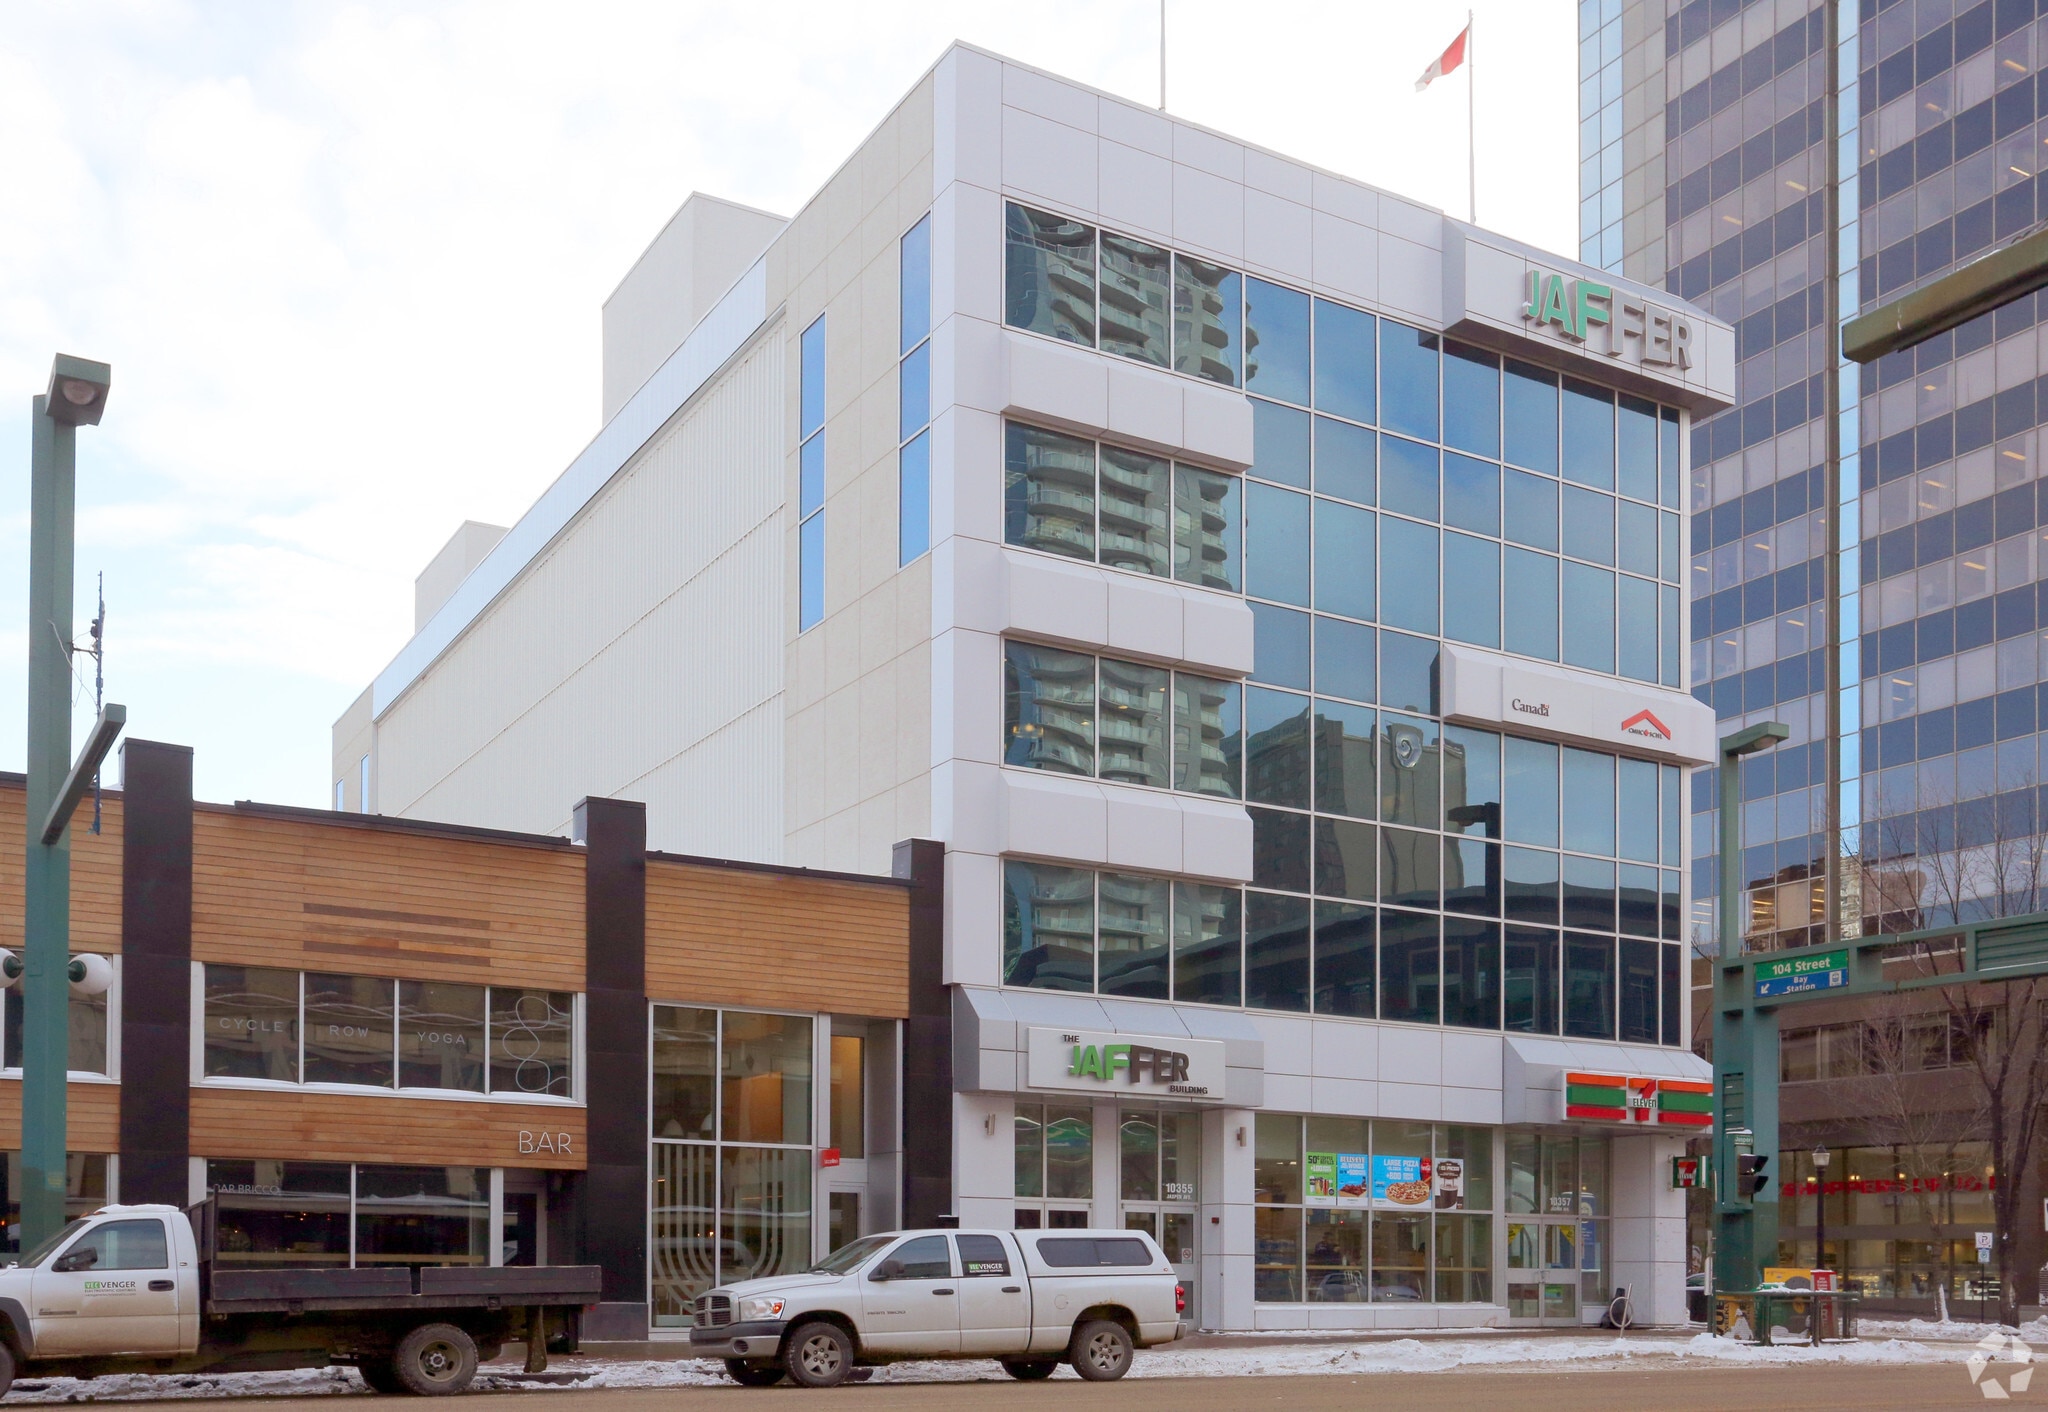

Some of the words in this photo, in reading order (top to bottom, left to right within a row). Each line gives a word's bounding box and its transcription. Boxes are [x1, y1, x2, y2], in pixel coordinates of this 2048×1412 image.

[1522, 270, 1693, 370] JAFFER
[1512, 698, 1549, 717] Canada
[1772, 963, 1791, 975] 104
[1795, 957, 1830, 972] Street
[1793, 976, 1808, 984] Bay
[1786, 983, 1815, 993] Station
[219, 1017, 284, 1032] CYCLE
[329, 1025, 369, 1037] ROW
[417, 1031, 466, 1045] YOGA
[1063, 1034, 1080, 1043] THE
[1067, 1044, 1190, 1083] JAFFER
[1169, 1085, 1208, 1095] BUILDING
[1628, 1078, 1657, 1121] 7
[519, 1130, 572, 1154] BAR
[238, 1184, 280, 1194] BRICCO
[1165, 1183, 1193, 1194] 10355
[1550, 1197, 1571, 1207] 10357
